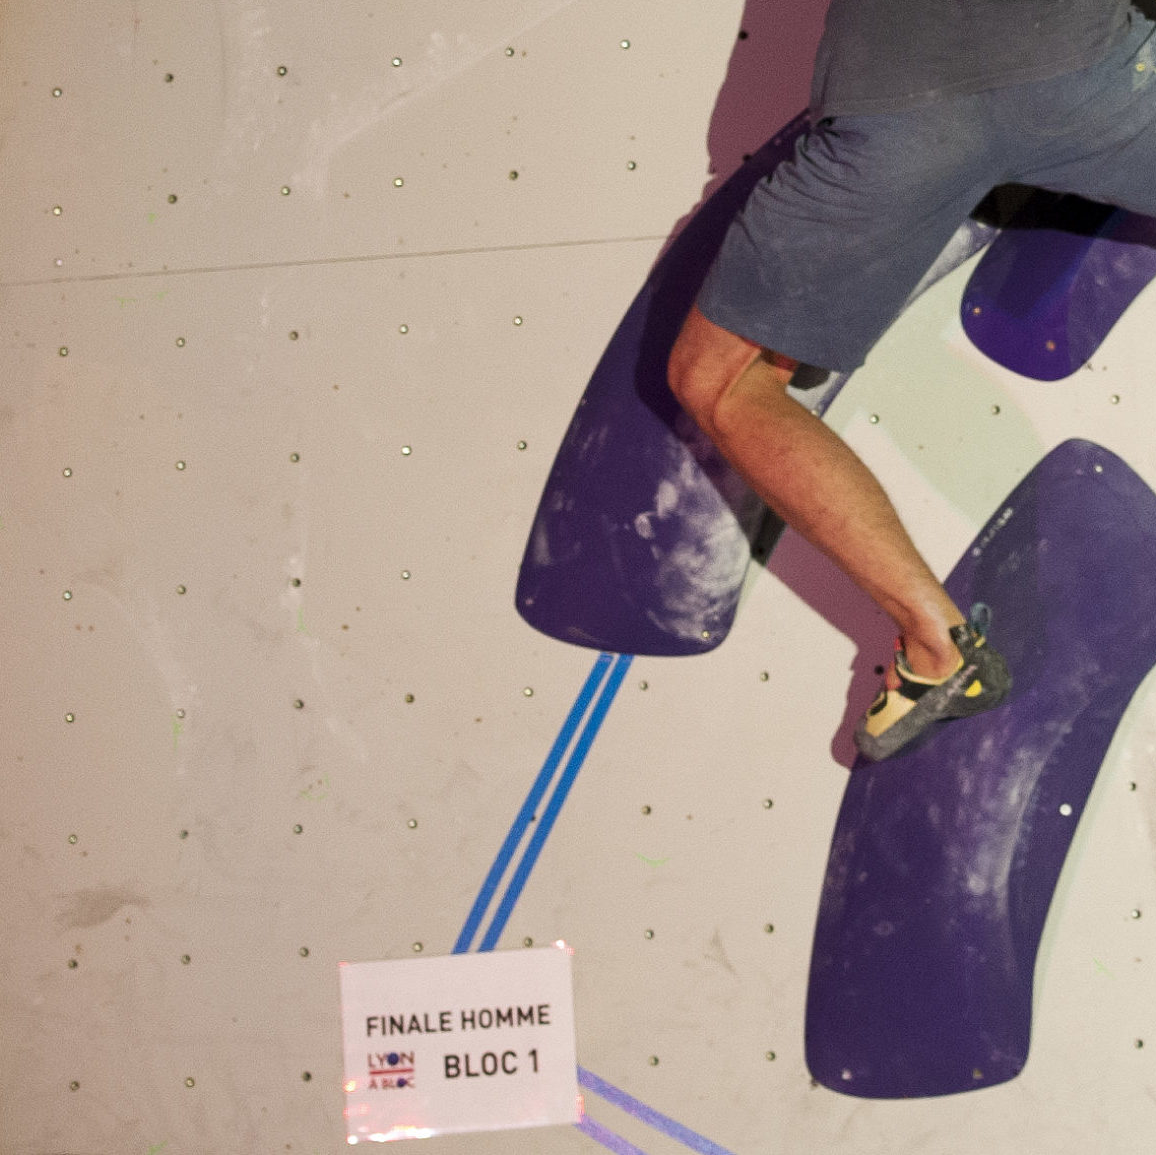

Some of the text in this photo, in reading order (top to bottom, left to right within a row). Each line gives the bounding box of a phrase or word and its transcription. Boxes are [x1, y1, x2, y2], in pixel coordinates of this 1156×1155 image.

[366, 1004, 551, 1037] FINALE HOMME
[367, 1051, 415, 1068] LYON
[444, 1049, 539, 1079] BLOC 1
